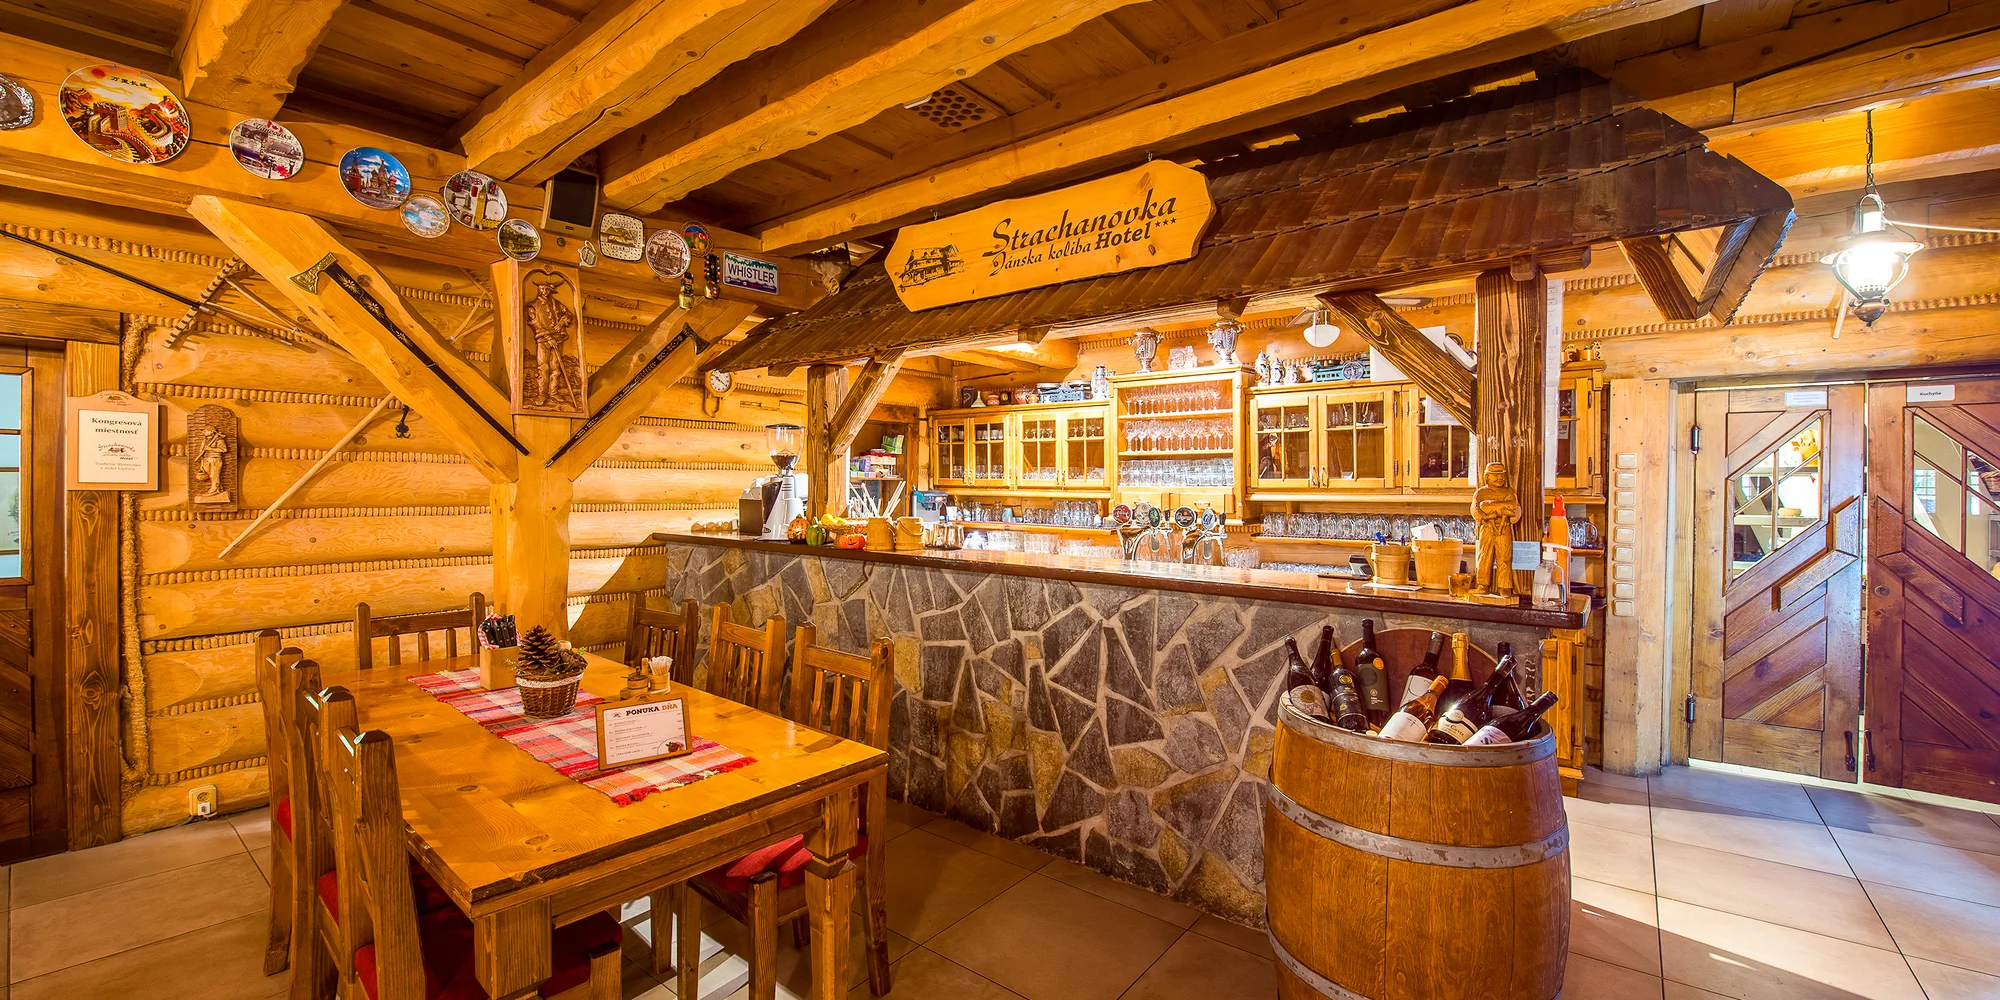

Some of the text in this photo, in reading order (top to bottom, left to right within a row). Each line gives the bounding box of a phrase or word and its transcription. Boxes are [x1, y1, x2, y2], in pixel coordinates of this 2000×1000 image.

[981, 187, 1178, 258] Strachanovka
[988, 221, 1151, 277] Jánska koliba Hotel
[727, 262, 776, 284] WHISTLER
[91, 417, 142, 427] Kongresová
[95, 426, 139, 435] miestnosť
[625, 702, 679, 716] PONUKA DŇA
